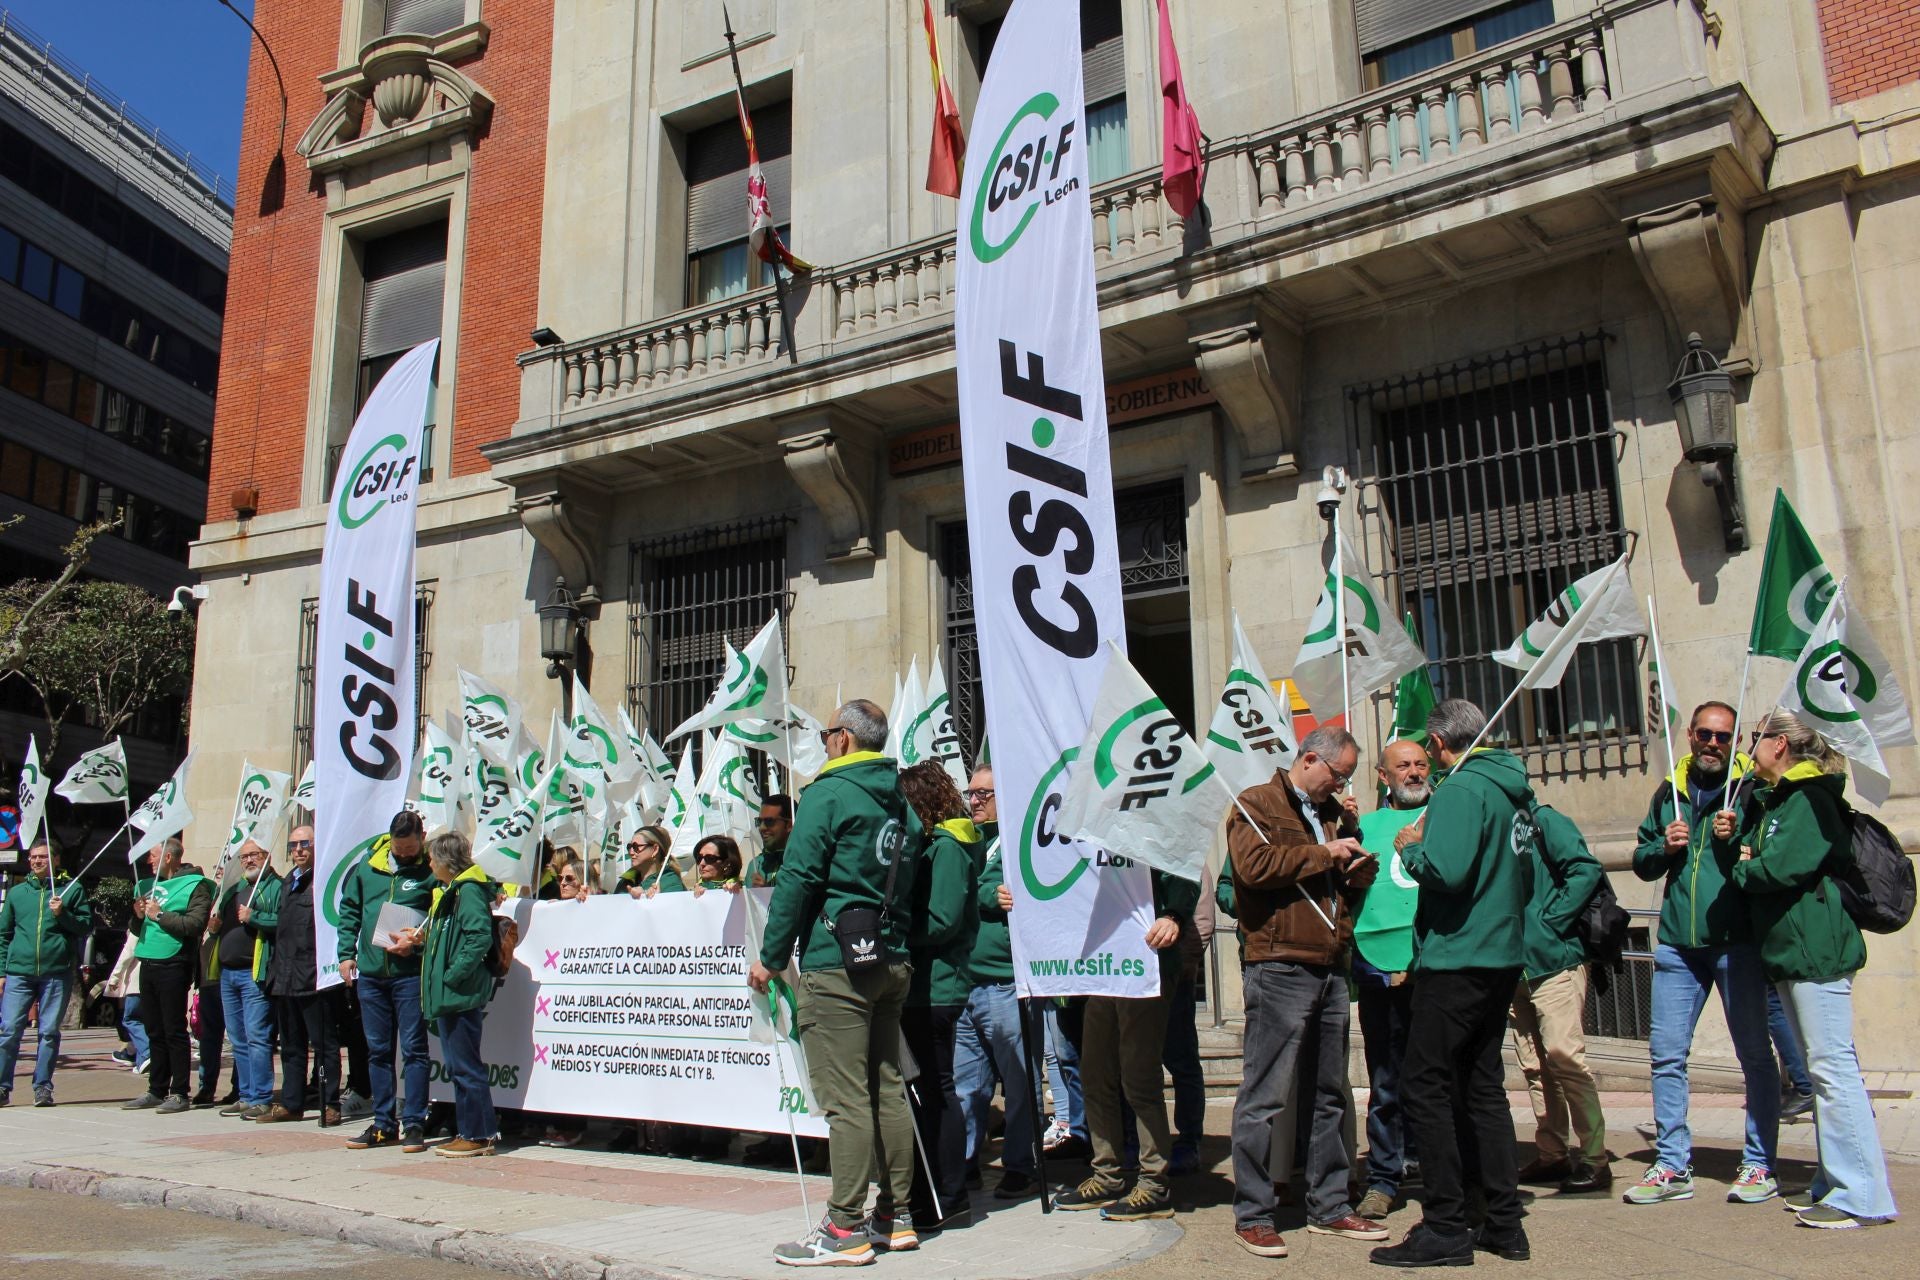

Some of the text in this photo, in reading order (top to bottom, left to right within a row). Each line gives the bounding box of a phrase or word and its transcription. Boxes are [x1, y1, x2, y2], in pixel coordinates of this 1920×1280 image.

[1044, 176, 1080, 206] León
[890, 433, 960, 465] SUBDEL
[390, 491, 409, 504] Leó
[1221, 687, 1290, 755] CSIF
[19, 781, 35, 808] SIF
[244, 791, 273, 817] CSIF
[883, 831, 910, 851] CSF
[563, 947, 577, 959] UN
[579, 946, 624, 959] ESTATUTO
[627, 946, 655, 959] PARA
[656, 946, 691, 958] TODAS
[695, 946, 713, 959] LAS
[853, 953, 878, 963] adidas
[560, 962, 746, 975] GARANTICE LA CALIDAD ASISTENCIAL.
[1030, 953, 1145, 976] www.csif.es
[554, 992, 751, 1011] UNA JUBILACIÓN PARCIAL, ANTICIPADA
[553, 1010, 753, 1029] COEFICIENTES PARA PERSONAL ESTATUT
[552, 1042, 771, 1067] UNA ADECUACIÓN INMEDIATA DE TÉCNICOS
[486, 1063, 520, 1089] D@S
[593, 1061, 601, 1073] Y
[603, 1061, 667, 1077] SUPERIORES
[669, 1066, 683, 1078] AL
[684, 1066, 696, 1079] C1
[696, 1067, 705, 1079] Y
[706, 1068, 715, 1080] B.
